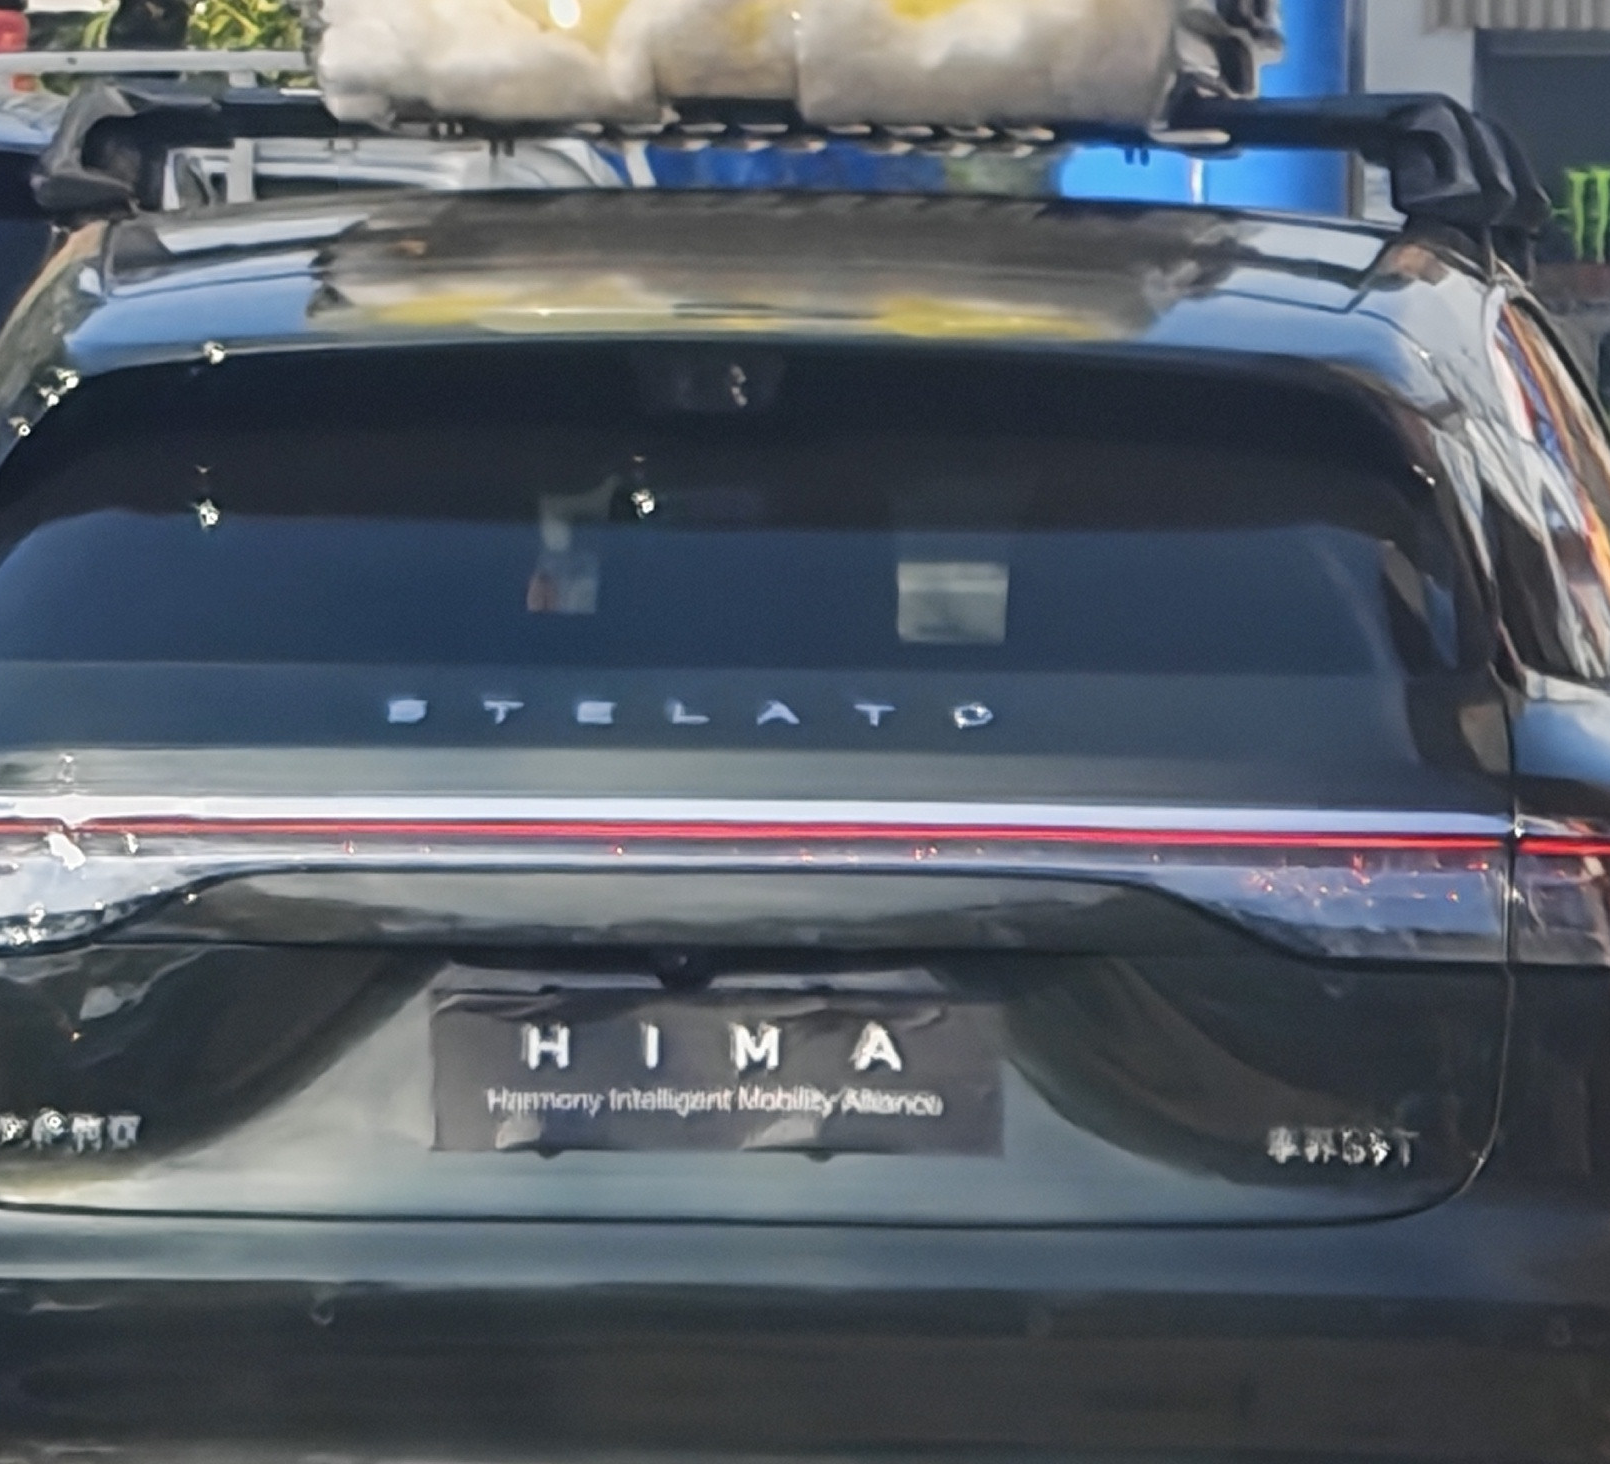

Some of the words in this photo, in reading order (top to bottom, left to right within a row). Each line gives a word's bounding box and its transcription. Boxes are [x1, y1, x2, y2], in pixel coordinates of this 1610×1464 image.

[386, 697, 994, 729] STELATO
[486, 1087, 605, 1118] Harmony
[608, 1087, 735, 1118] Intelligent
[738, 1084, 835, 1119] Mobility
[841, 1087, 945, 1116] Alliance
